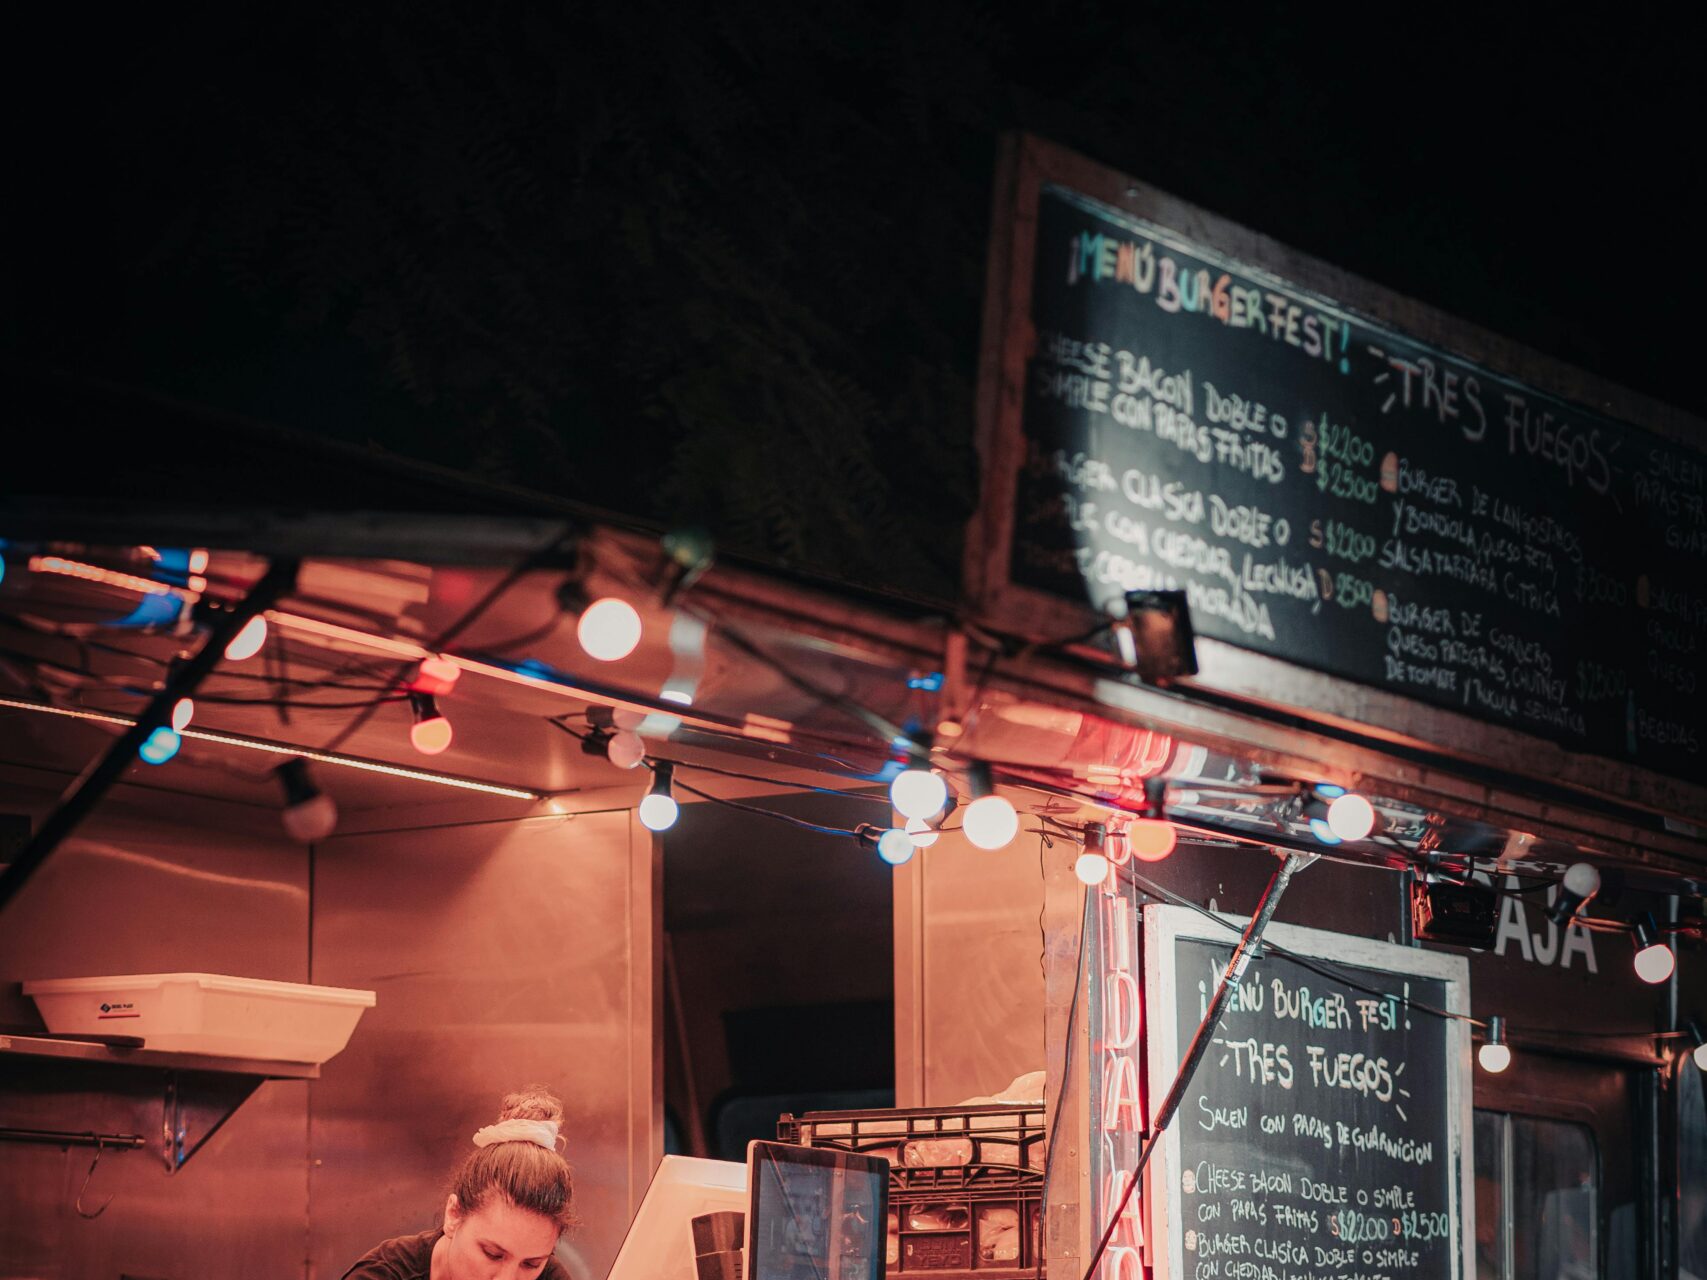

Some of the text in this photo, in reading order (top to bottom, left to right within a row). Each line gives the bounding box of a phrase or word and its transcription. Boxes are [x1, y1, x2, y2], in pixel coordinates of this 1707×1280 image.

[1156, 256, 1266, 334] BURGER
[1114, 350, 1194, 416] BACON
[1204, 382, 1267, 431] DOBLE
[1387, 356, 1611, 497] TRES FUEGOS
[1399, 457, 1463, 509] BURGER
[1208, 495, 1272, 548] DOBLE
[1387, 592, 1456, 637] BURGER
[1271, 977, 1352, 1030] BURGER
[1225, 1037, 1393, 1102] TRES FUEGOS
[1199, 1095, 1248, 1131] SALEN
[1260, 1114, 1286, 1133] CON
[1293, 1113, 1333, 1149] PAPAS
[1336, 1121, 1350, 1146] DE
[1195, 1160, 1416, 1210] CHEESE BACON DOBLE O SIMPLE
[1197, 1203, 1221, 1223] CON
[1231, 1199, 1268, 1226] PAPAS
[1272, 1205, 1319, 1234] FRITAS
[1338, 1209, 1388, 1244] $2200
[1402, 1209, 1449, 1242] $2500
[1198, 1231, 1420, 1269] BURGER CLASICA DOBLE O SIMPLE
